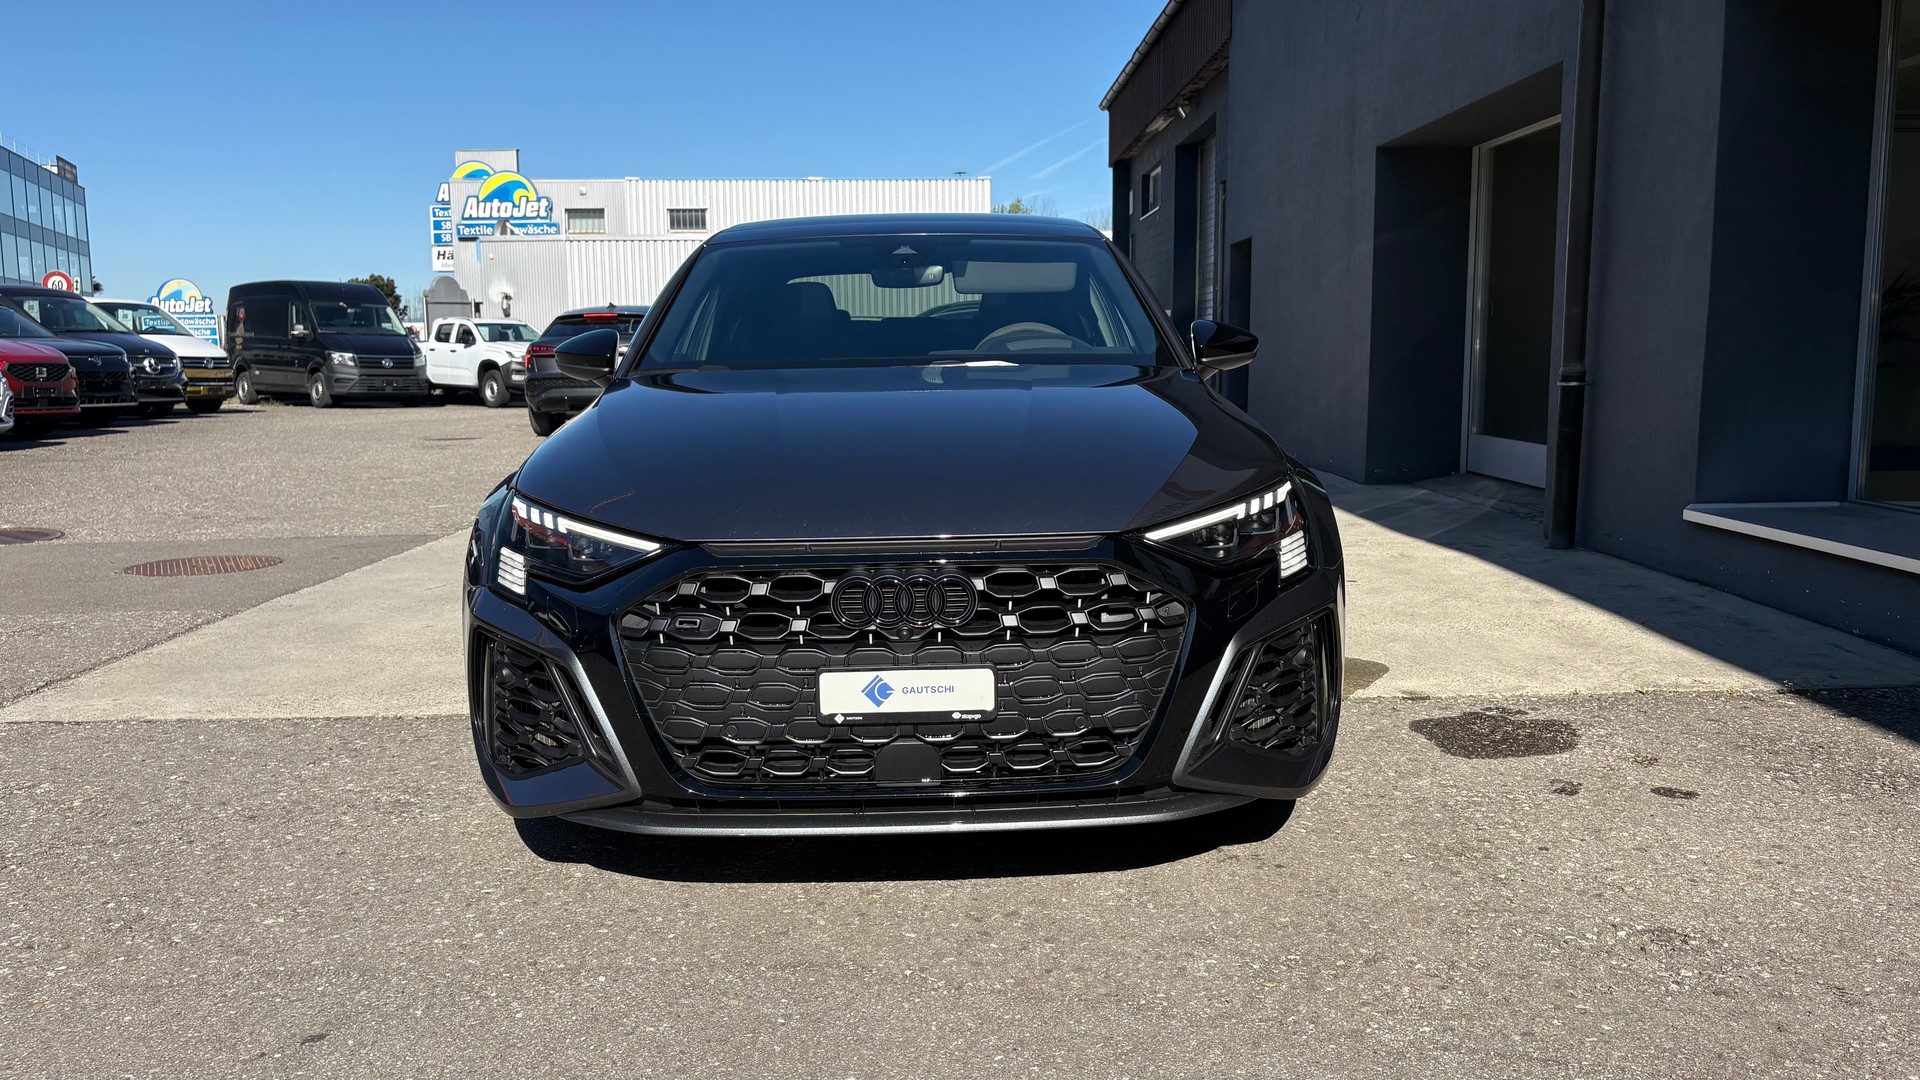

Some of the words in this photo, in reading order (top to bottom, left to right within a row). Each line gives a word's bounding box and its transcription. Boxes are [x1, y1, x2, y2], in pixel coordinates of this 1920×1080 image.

[463, 196, 549, 218] AutoJet
[441, 221, 451, 230] SB
[458, 224, 493, 235] Textile
[515, 224, 557, 235] wäsche
[441, 233, 451, 242] SB
[51, 279, 63, 290] 60
[151, 296, 212, 313] AutoJet
[901, 685, 955, 695] GAUTSCHI
